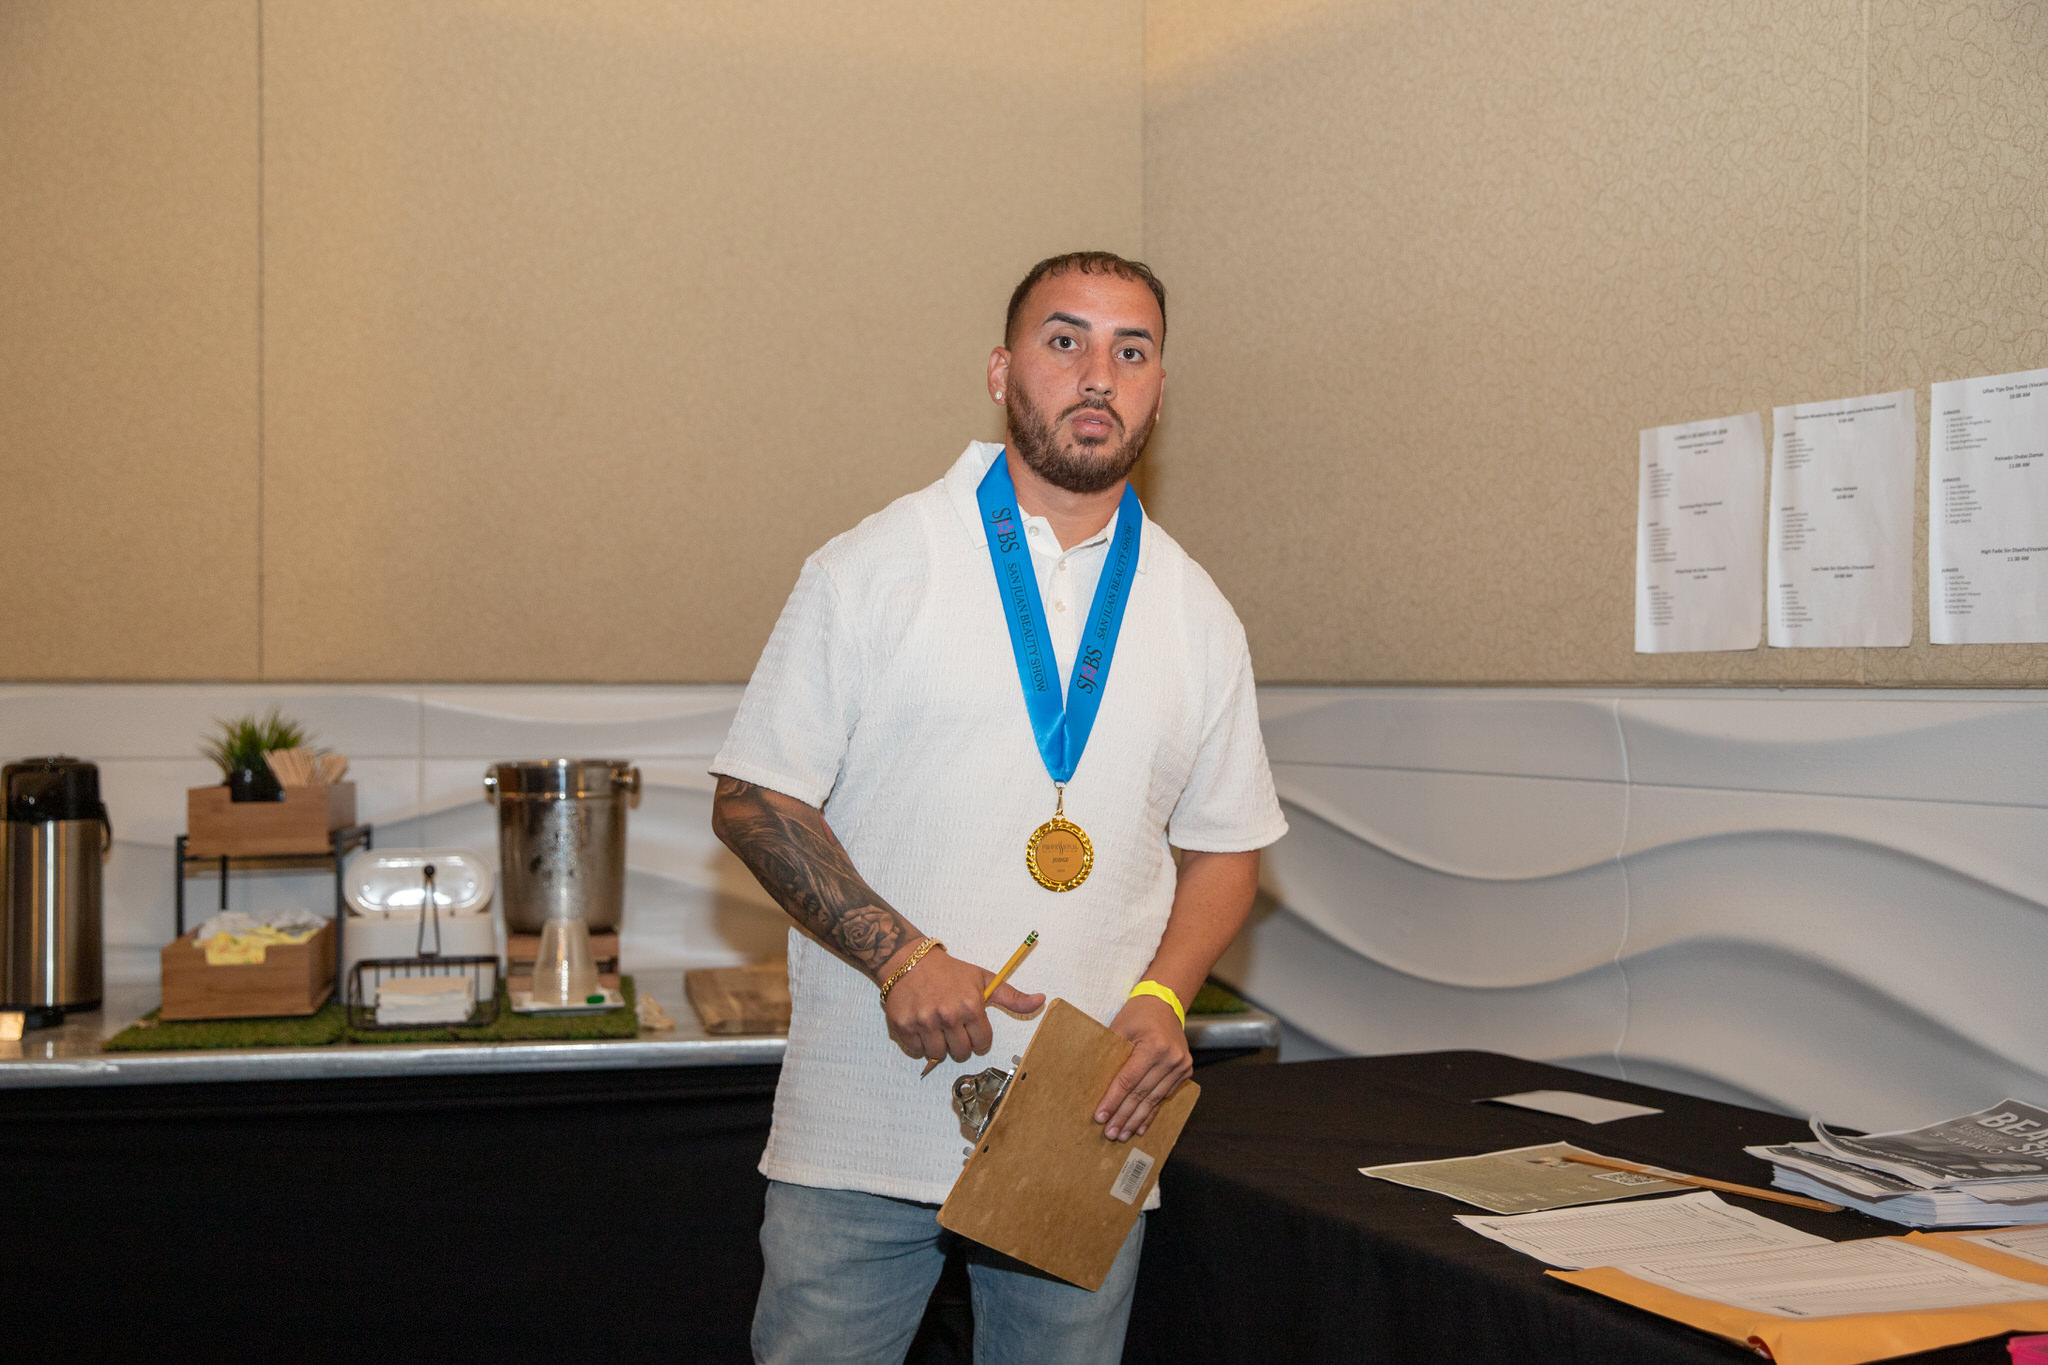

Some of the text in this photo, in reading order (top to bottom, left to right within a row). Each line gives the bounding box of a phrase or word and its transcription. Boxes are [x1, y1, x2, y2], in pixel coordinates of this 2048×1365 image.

[1121, 524, 1133, 552] SHOW
[1008, 563, 1020, 586] SAN
[1112, 552, 1129, 591] BEAUTY
[1010, 586, 1027, 612] JUAN
[1103, 592, 1117, 620] JUAN
[1020, 614, 1040, 655] BEAUTY
[1096, 617, 1111, 640] SAN
[1031, 656, 1047, 692] SHOW
